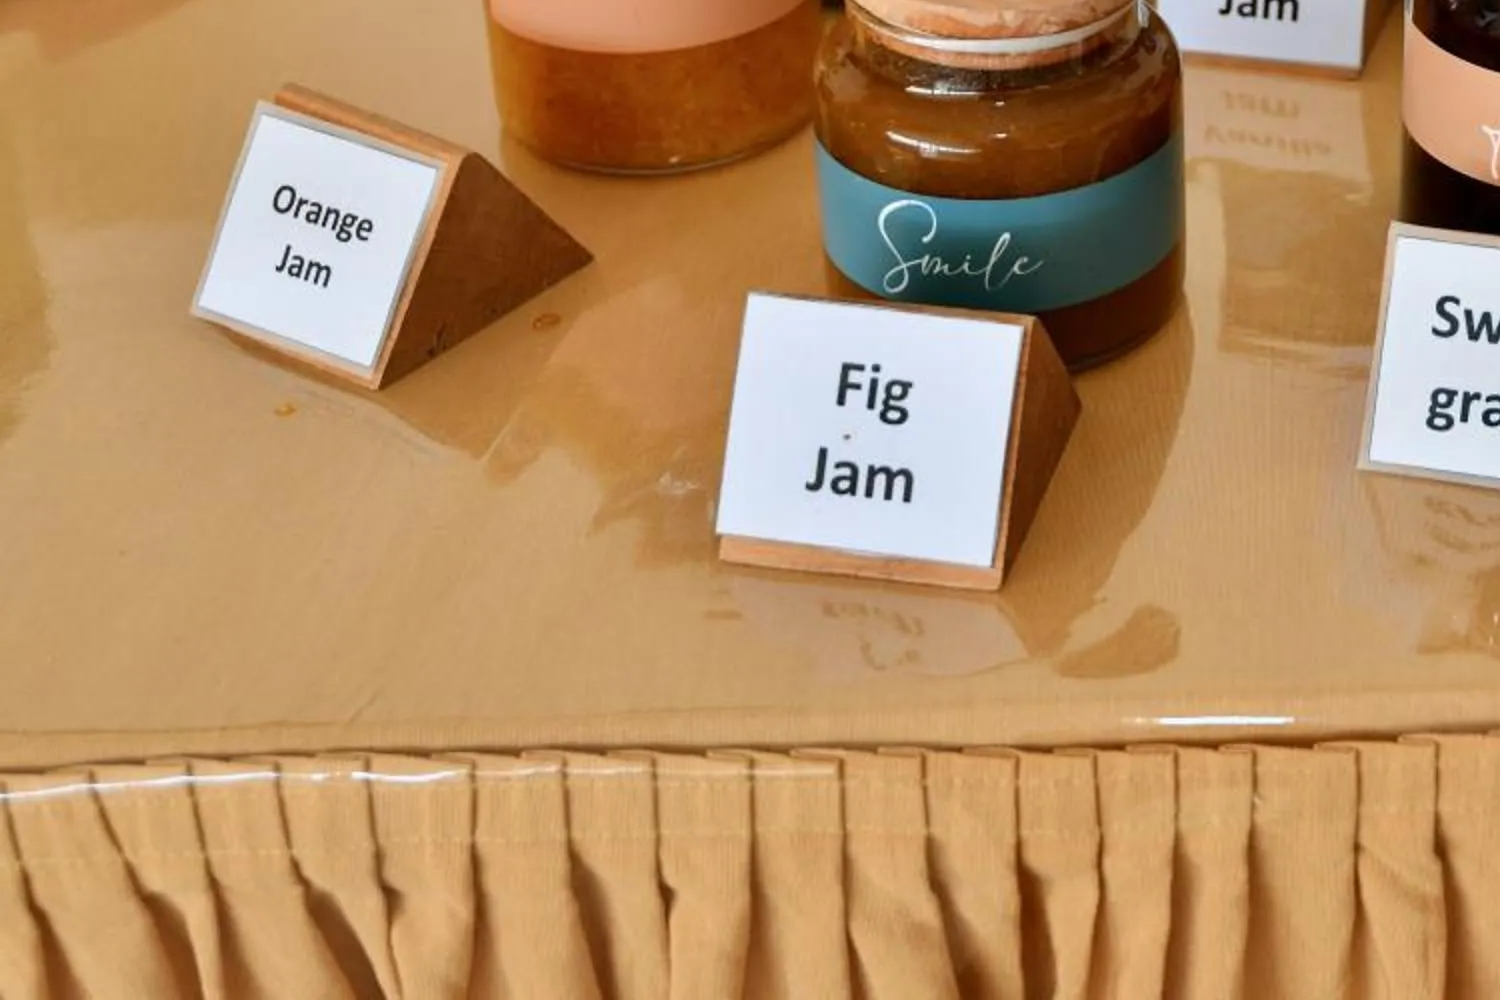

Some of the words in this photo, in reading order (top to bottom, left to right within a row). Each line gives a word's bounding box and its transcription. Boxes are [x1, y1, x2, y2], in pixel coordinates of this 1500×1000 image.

[272, 184, 374, 243] Orange
[274, 244, 333, 288] Jam
[877, 199, 1044, 293] Smile
[835, 362, 914, 425] Fig
[805, 446, 914, 503] Jam
